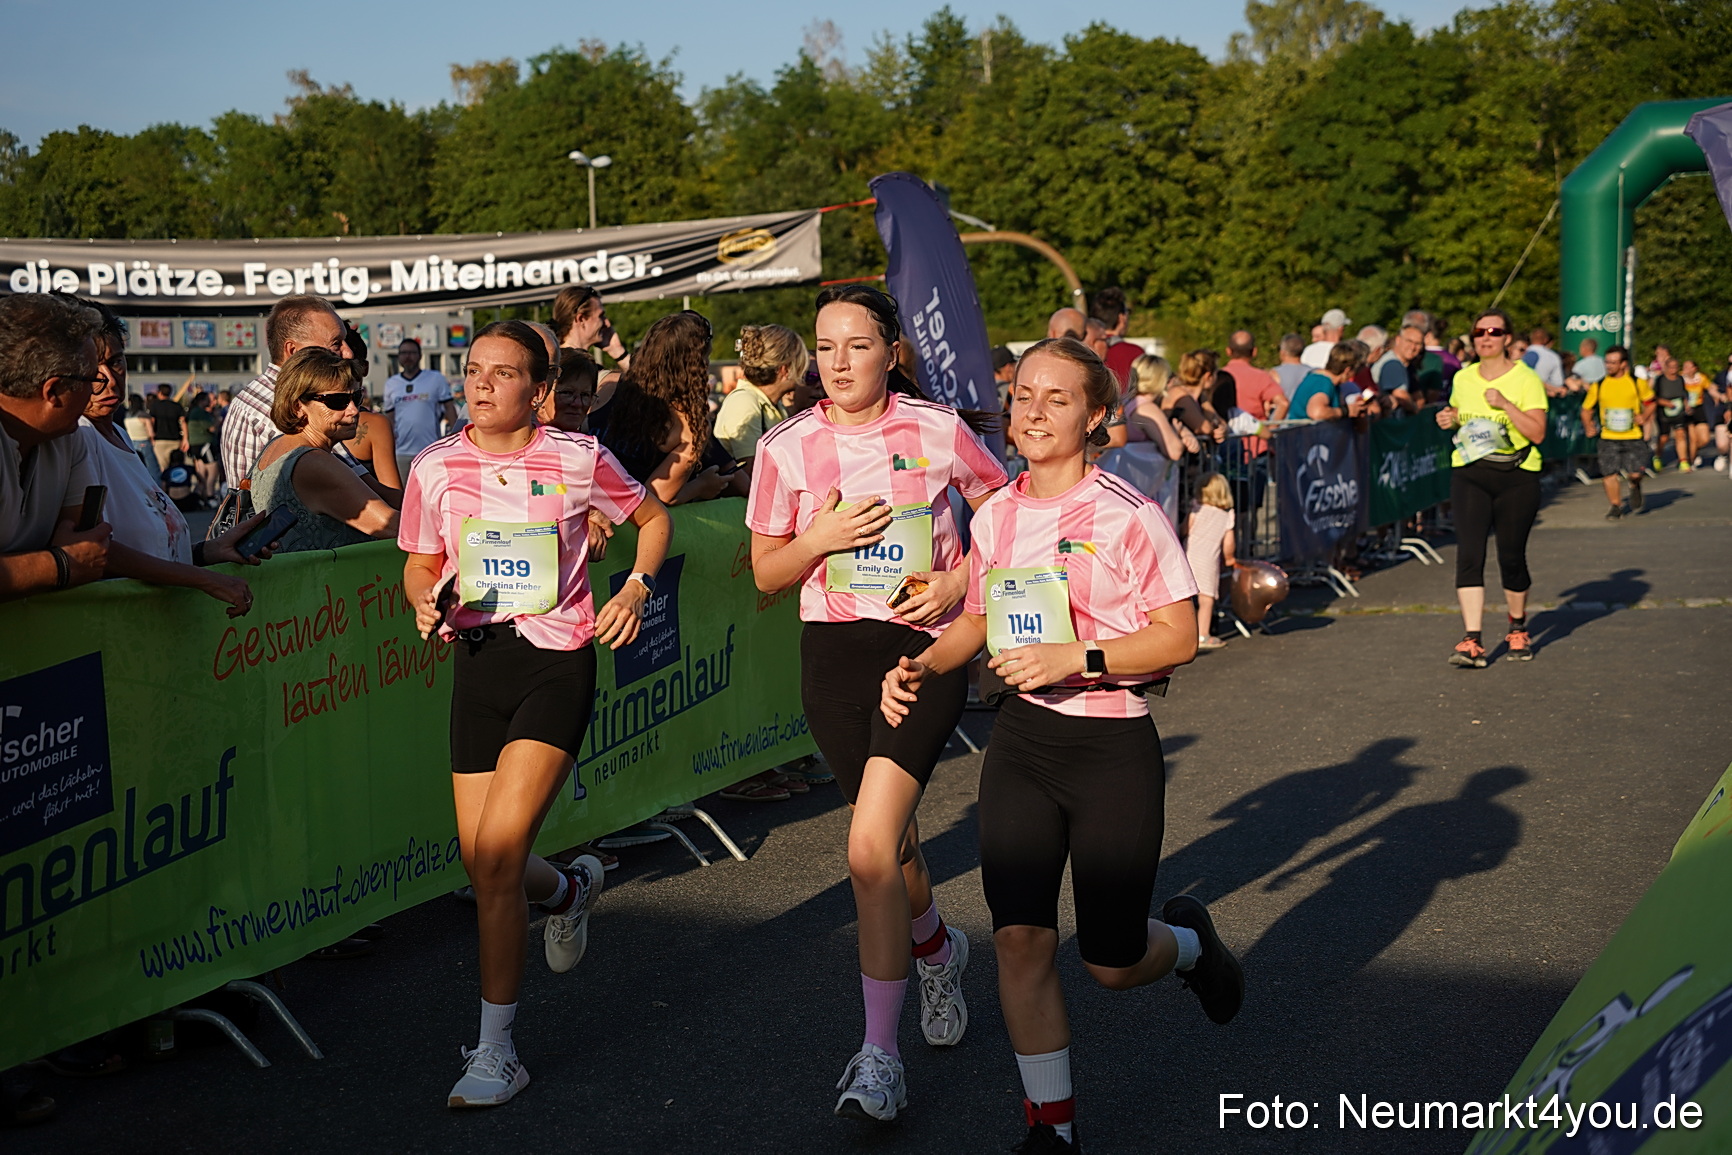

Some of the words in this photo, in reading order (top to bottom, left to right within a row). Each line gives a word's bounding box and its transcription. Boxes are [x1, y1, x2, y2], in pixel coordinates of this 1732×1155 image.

[9, 258, 80, 294] die
[88, 260, 236, 297] Plätze.
[243, 257, 382, 304] Fertig.
[391, 249, 664, 292] Miteinander.
[1565, 314, 1603, 332] AOK
[1305, 473, 1359, 513] Fische
[854, 543, 904, 562] 1140
[483, 558, 531, 578] 1139
[857, 564, 881, 574] Emily
[883, 565, 902, 574] Graf
[475, 580, 514, 590] Christina
[515, 582, 541, 591] Fieber
[642, 593, 669, 618] cher
[641, 612, 667, 631] OMOBILE
[1008, 613, 1042, 635] 1141
[1015, 635, 1042, 644] Kristina
[282, 652, 370, 728] laufen
[377, 635, 457, 689] länge
[589, 624, 735, 757] firmenlauf
[0, 744, 79, 785] UTOMOBILE
[594, 730, 660, 787] neumarkt
[12, 791, 35, 816] und
[38, 783, 59, 801] das
[43, 795, 73, 827] fährt
[75, 778, 101, 803] mit!
